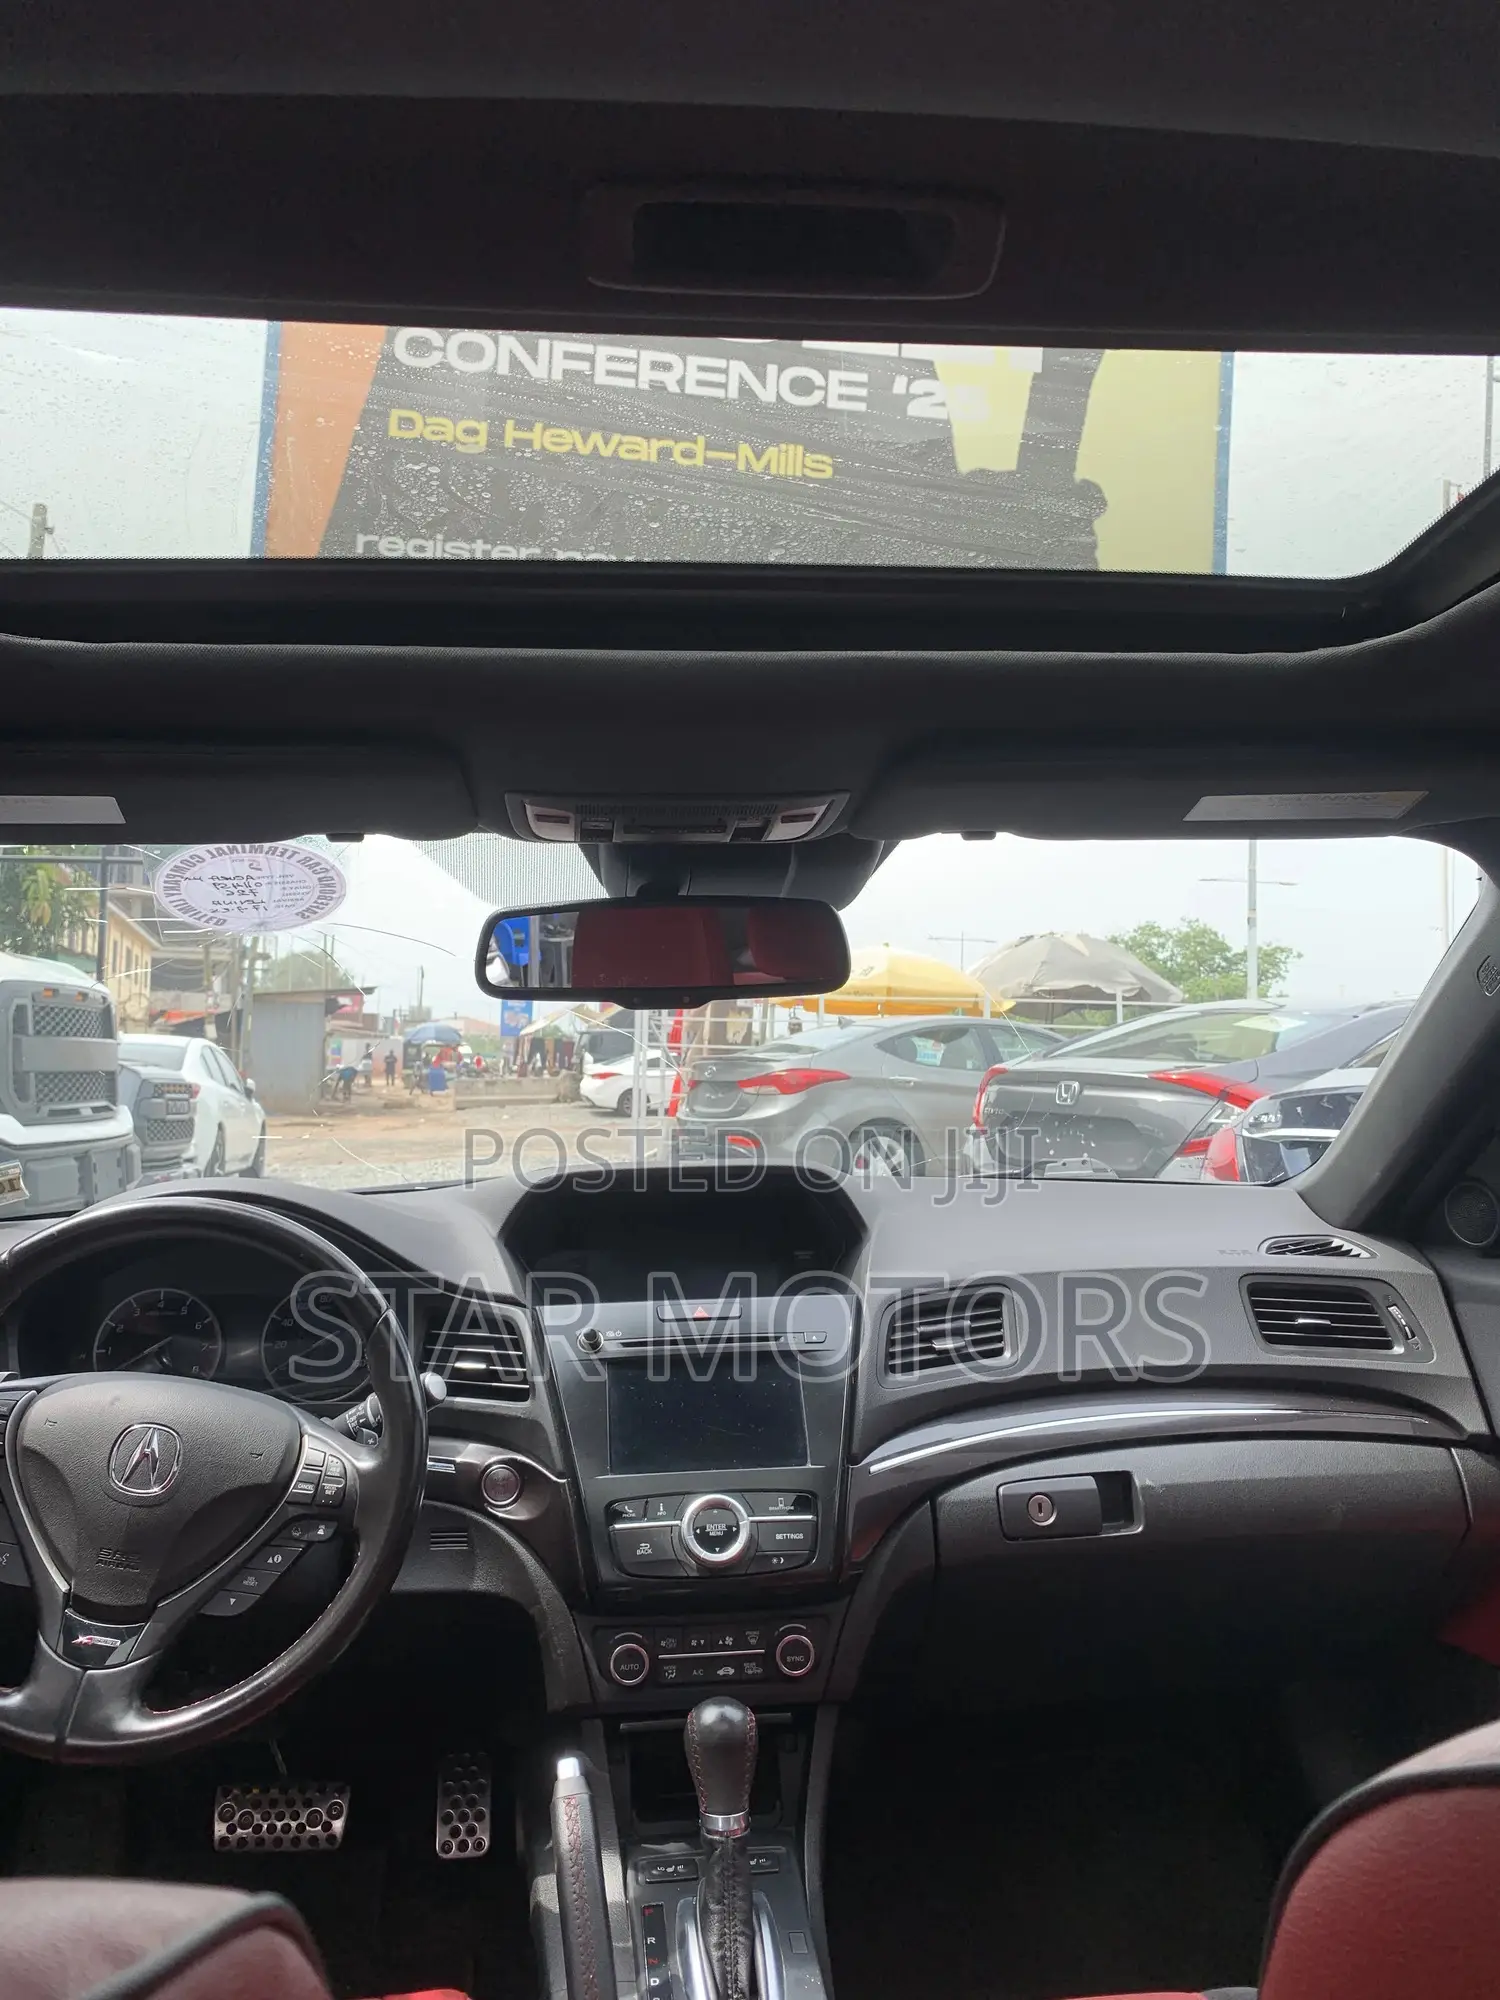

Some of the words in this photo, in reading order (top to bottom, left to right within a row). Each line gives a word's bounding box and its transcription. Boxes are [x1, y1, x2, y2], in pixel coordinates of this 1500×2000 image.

[394, 327, 868, 412] CONFERENCE
[388, 409, 488, 454] Dag
[706, 1523, 727, 1531] ENTER
[620, 1663, 640, 1671] AUTO
[647, 1937, 656, 1945] R
[650, 1977, 660, 1986] D
